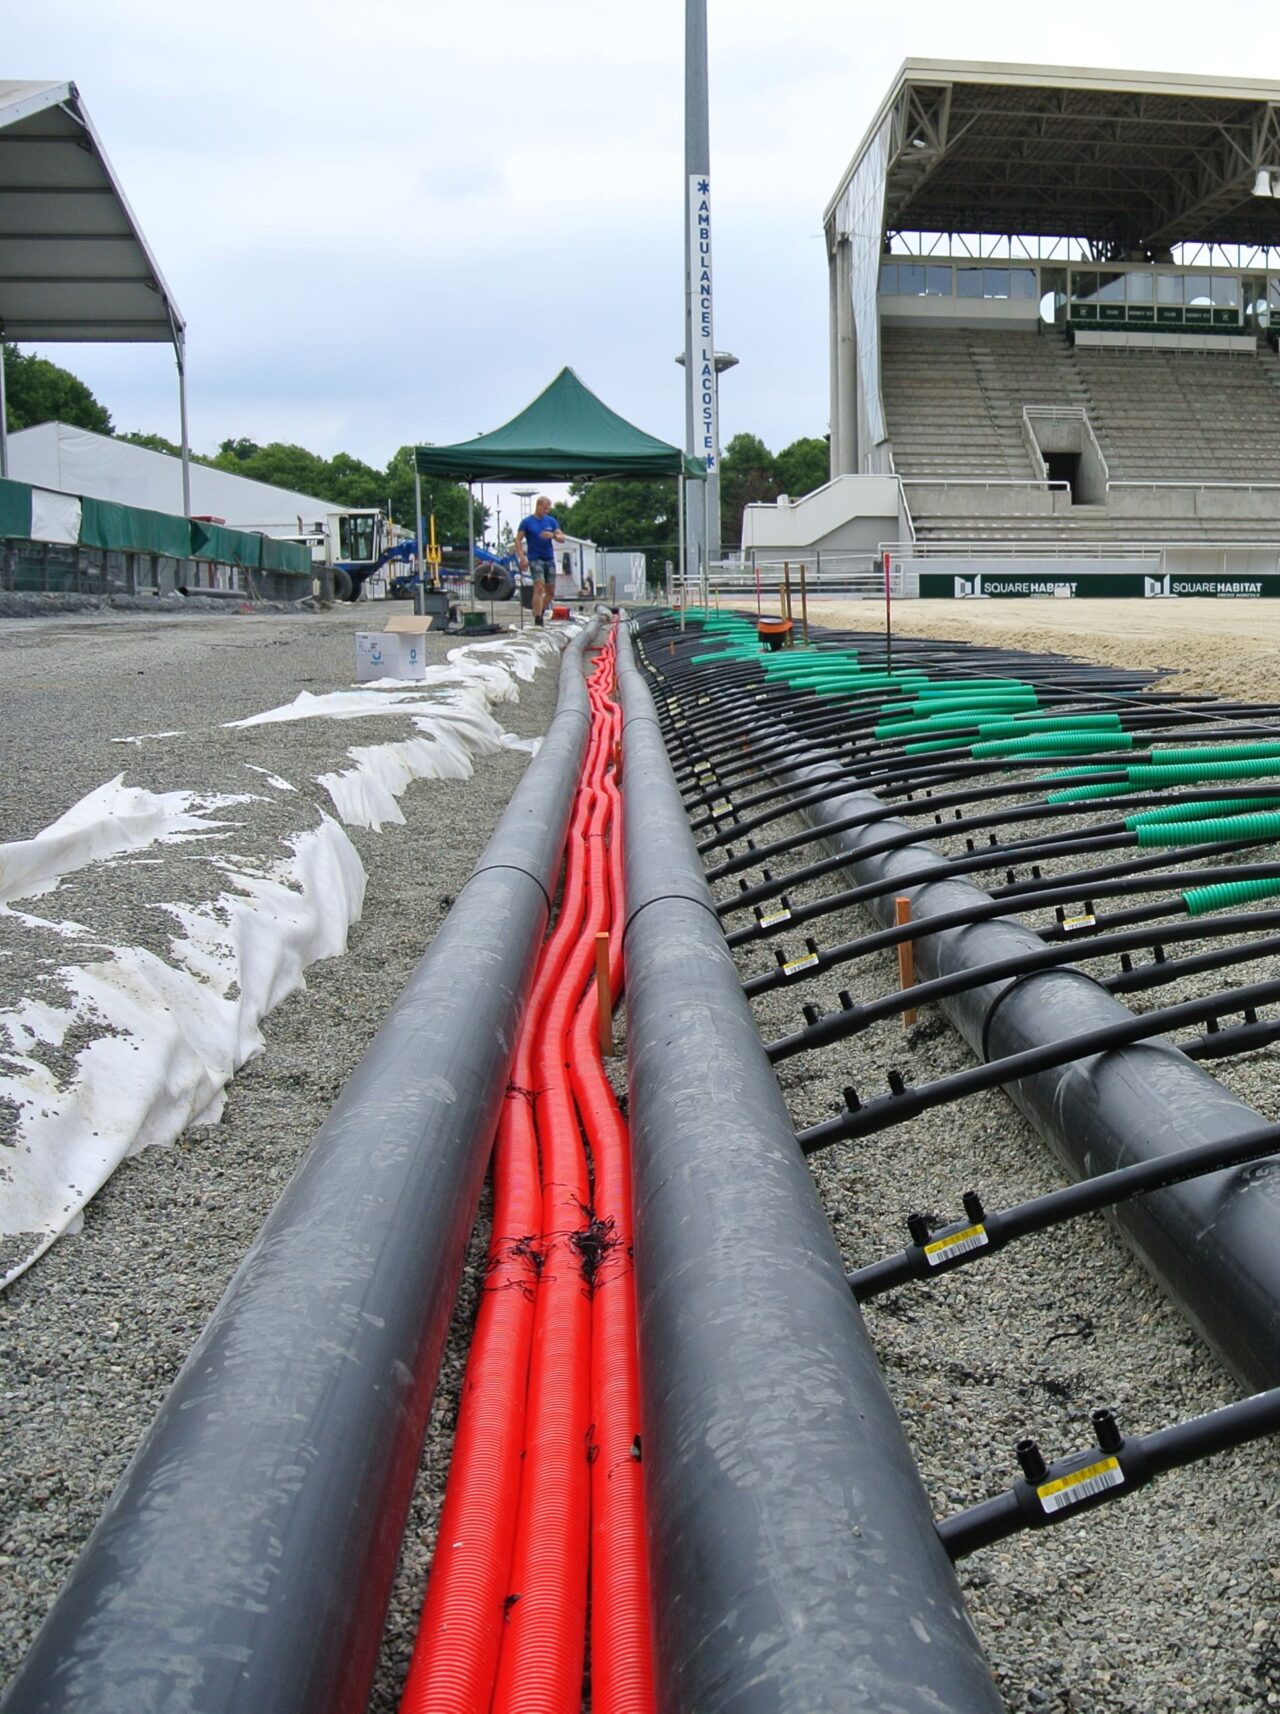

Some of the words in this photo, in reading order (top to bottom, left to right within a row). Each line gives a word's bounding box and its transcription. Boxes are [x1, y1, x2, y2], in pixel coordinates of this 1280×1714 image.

[697, 200, 711, 338] AMBULANCES
[701, 349, 712, 449] LACOSTE
[984, 582, 1029, 593] SQUARE
[1172, 582, 1217, 593] SQUARE
[1217, 582, 1263, 593] HABITAT
